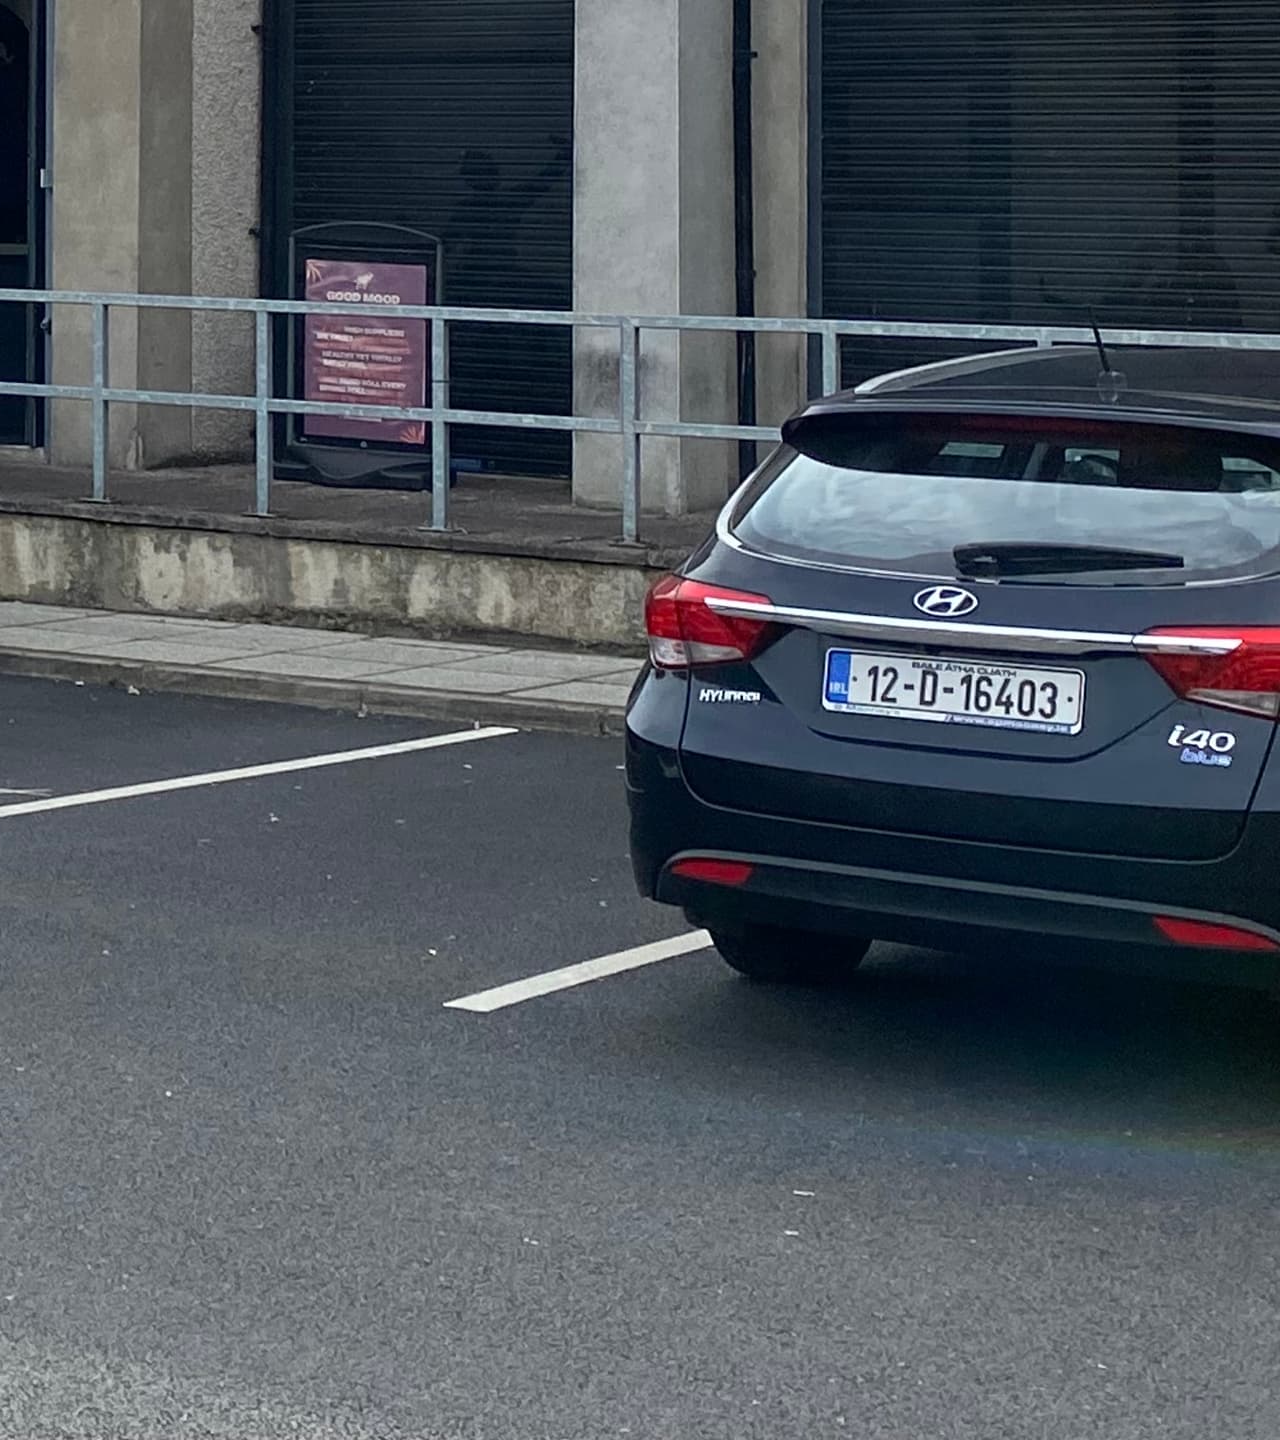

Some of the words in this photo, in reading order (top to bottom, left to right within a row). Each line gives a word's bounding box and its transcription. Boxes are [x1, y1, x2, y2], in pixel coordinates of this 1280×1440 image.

[326, 291, 361, 302] GOOD
[363, 292, 401, 304] MOOD
[912, 661, 943, 672] BAILE
[977, 666, 1017, 679] CLIATH
[829, 681, 849, 695] IRL
[867, 665, 1059, 720] 12-D-16403
[1168, 724, 1236, 753] i40
